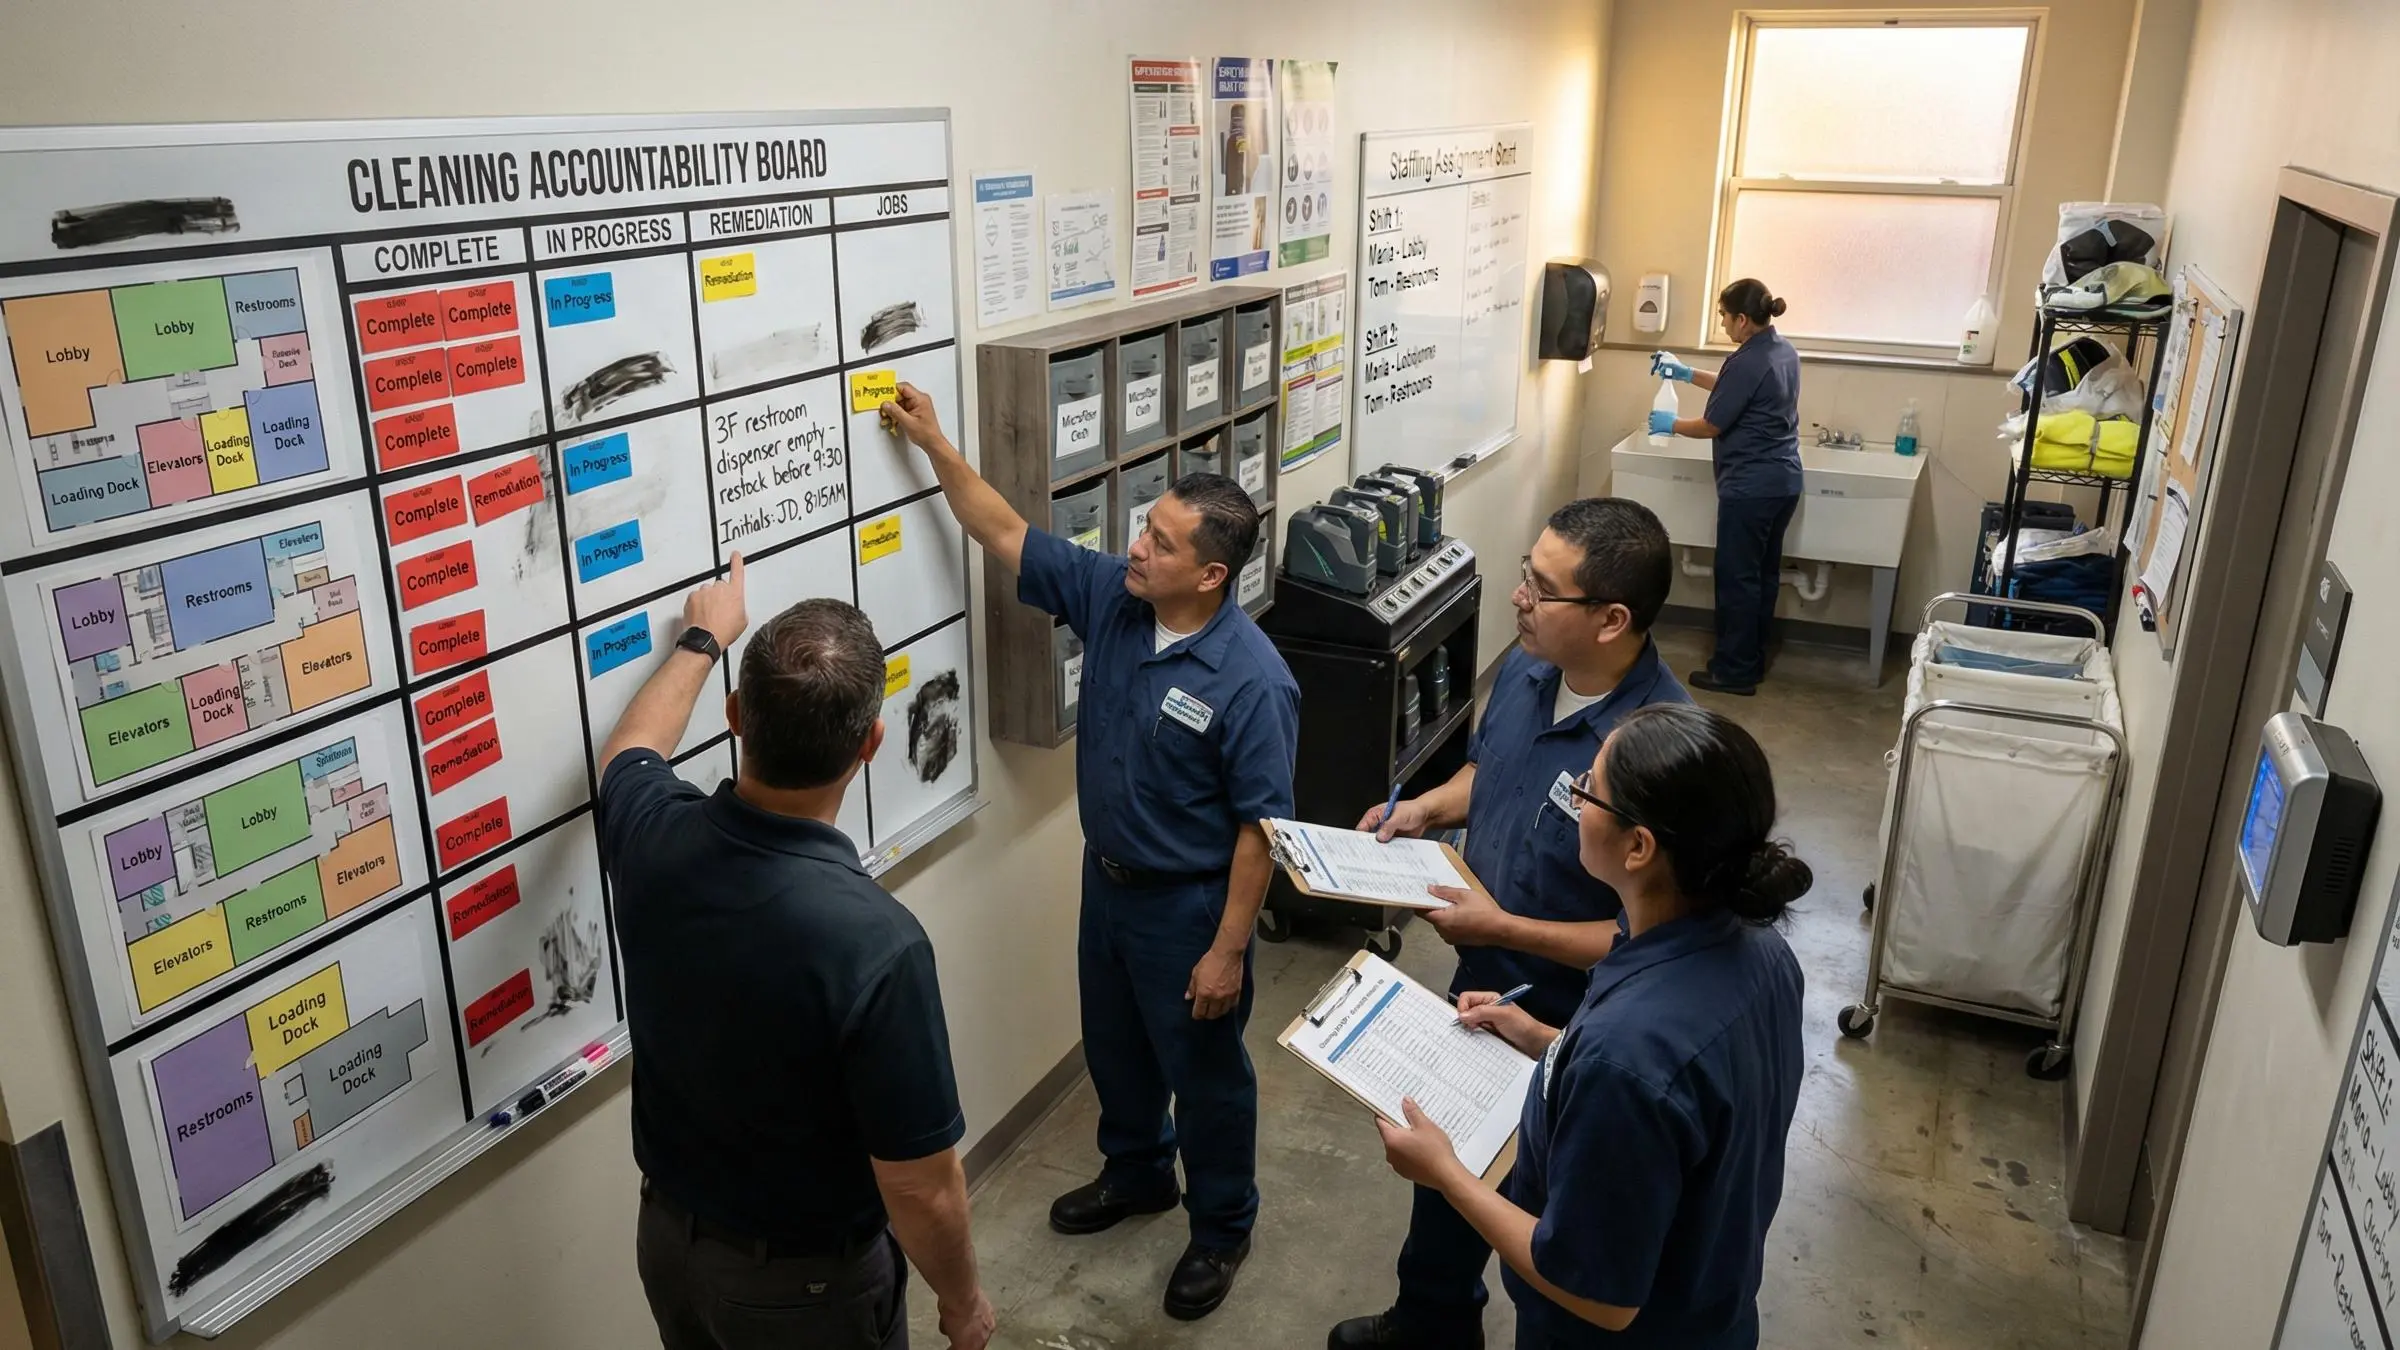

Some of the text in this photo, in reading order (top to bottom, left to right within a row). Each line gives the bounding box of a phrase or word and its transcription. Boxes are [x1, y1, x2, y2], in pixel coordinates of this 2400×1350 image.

[347, 138, 827, 213] CLEANING ACCOUNTABILITY BOARD
[876, 194, 908, 216] JOBS
[710, 204, 813, 235] REMEDIATION
[546, 218, 672, 254] IN PROGRESS
[374, 236, 500, 273] COMPLETE
[235, 296, 296, 315] Restrooms
[550, 292, 612, 310] In Progress
[154, 316, 195, 340] Lobby
[366, 312, 436, 336] Complete
[46, 344, 90, 368] Lobby
[456, 356, 518, 378] Complete
[375, 370, 442, 394] Complete
[262, 414, 311, 436] Loading
[714, 403, 808, 444] 3F restroom
[206, 434, 250, 453] Loading
[274, 431, 305, 450] Dock
[385, 426, 450, 452] Complete
[717, 440, 782, 475] dispenser
[787, 421, 825, 453] empty
[570, 452, 628, 476] In Progress
[720, 448, 842, 504] restock before 9:30
[50, 476, 140, 508] Loading Dock
[720, 507, 776, 544] Initials:
[582, 554, 593, 568] In
[407, 562, 470, 592] Complete
[185, 580, 252, 608] Restrooms
[72, 606, 116, 630] Lobby
[418, 630, 480, 656] Complete
[592, 646, 603, 660] In
[190, 684, 240, 710] Loading
[426, 690, 486, 726] Complete
[203, 704, 234, 722] Dock
[108, 716, 170, 746] Elevators
[242, 806, 278, 830] Lobby
[120, 844, 163, 871] Lobby
[246, 893, 308, 931] Restrooms
[154, 940, 214, 976] Elevators
[268, 992, 327, 1031] Loading
[282, 1017, 320, 1045] Dock
[329, 1042, 383, 1082] Loading
[342, 1068, 376, 1095] Dock
[177, 1090, 254, 1143] Restrooms
